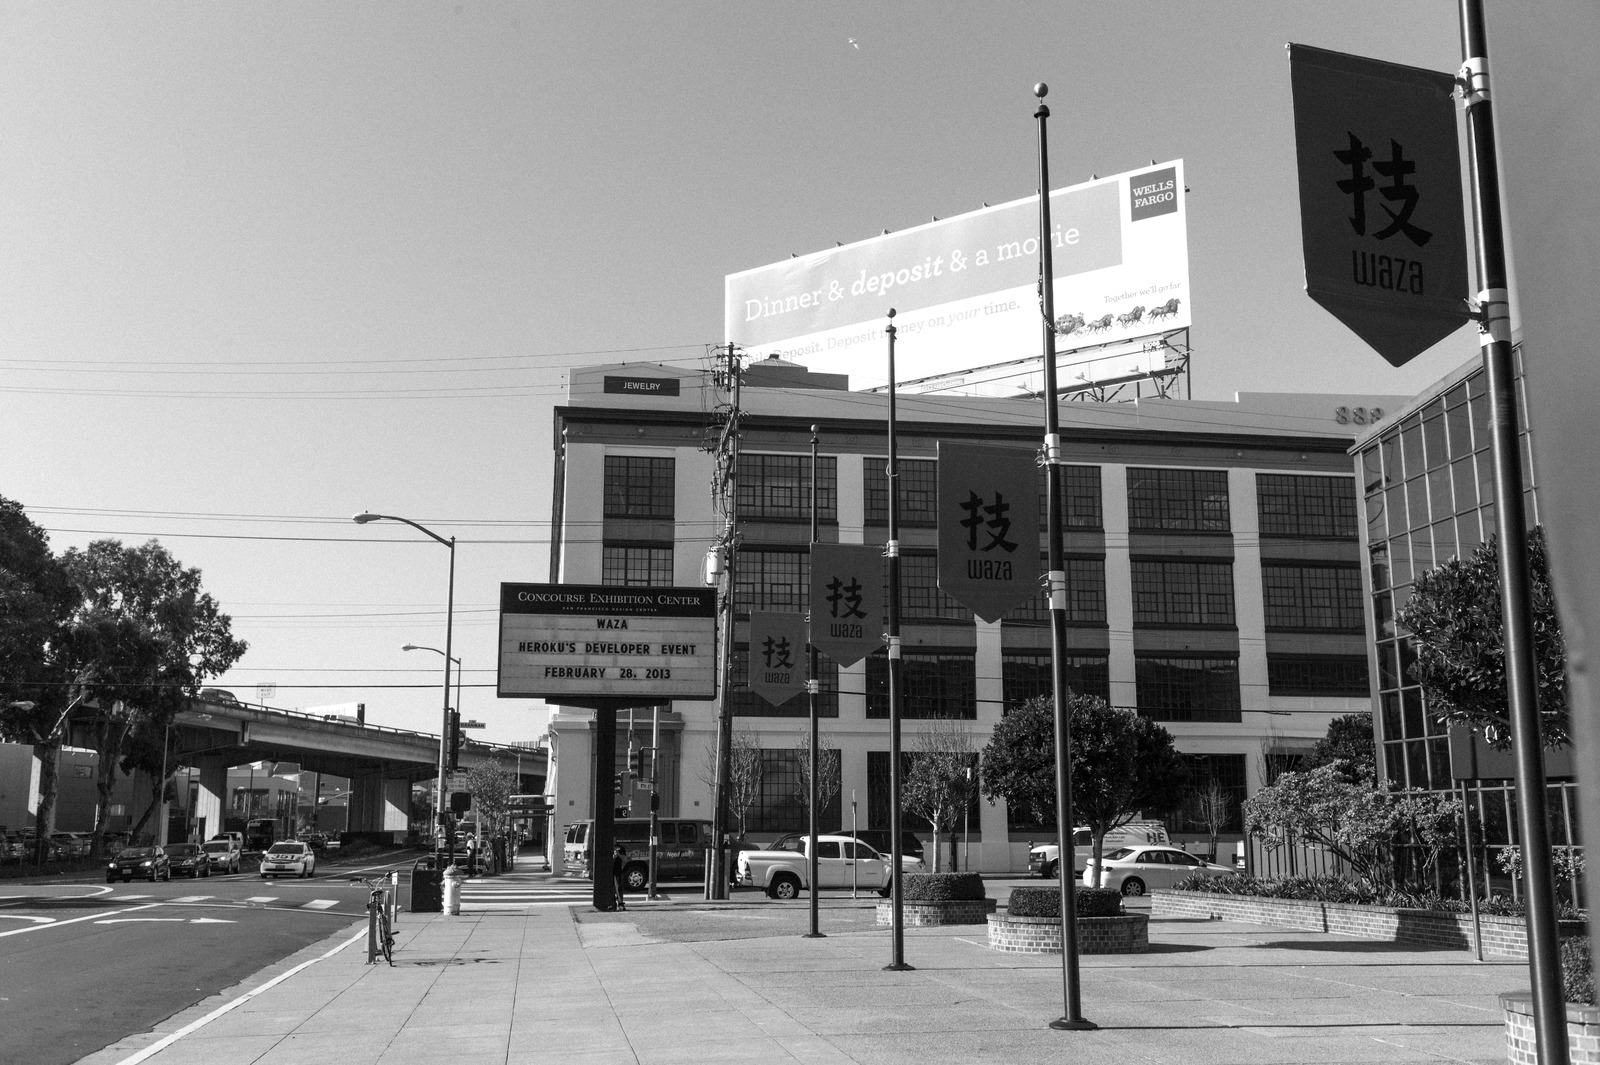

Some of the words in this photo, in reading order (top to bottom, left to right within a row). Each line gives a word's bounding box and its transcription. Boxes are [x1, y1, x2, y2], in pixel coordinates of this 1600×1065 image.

[1132, 180, 1174, 197] WELLS
[1333, 130, 1434, 248] 技
[1134, 192, 1174, 208] FARGO
[745, 289, 822, 321] Dinner
[828, 280, 845, 301] &
[851, 255, 944, 297] deposit
[949, 249, 968, 272] &
[975, 249, 990, 266] a
[996, 224, 1080, 261] moie
[1352, 250, 1424, 296] waza
[1103, 290, 1138, 304] Together
[1139, 285, 1157, 296] we'll
[1158, 285, 1169, 294] go
[1169, 281, 1182, 290] far
[827, 329, 877, 351] Deposit
[928, 317, 946, 328] on
[946, 307, 981, 327] your
[983, 300, 1021, 316] time.
[623, 382, 661, 390] JEWELRY
[959, 489, 1019, 553] 技
[967, 559, 1013, 581] waza
[518, 591, 585, 603] CONCOURSE
[590, 593, 653, 605] EXHIBITION
[657, 594, 701, 606] CENTER
[825, 575, 868, 619] 技
[596, 619, 628, 630] WAZA
[830, 623, 863, 639] waza
[519, 642, 576, 653] HEROKU'S
[585, 643, 650, 654] DEVELOPER
[661, 645, 697, 655] EVENT
[761, 635, 794, 669] 技
[544, 667, 605, 678] FEBRUARY
[645, 669, 671, 679] 2013
[765, 672, 790, 684] waza
